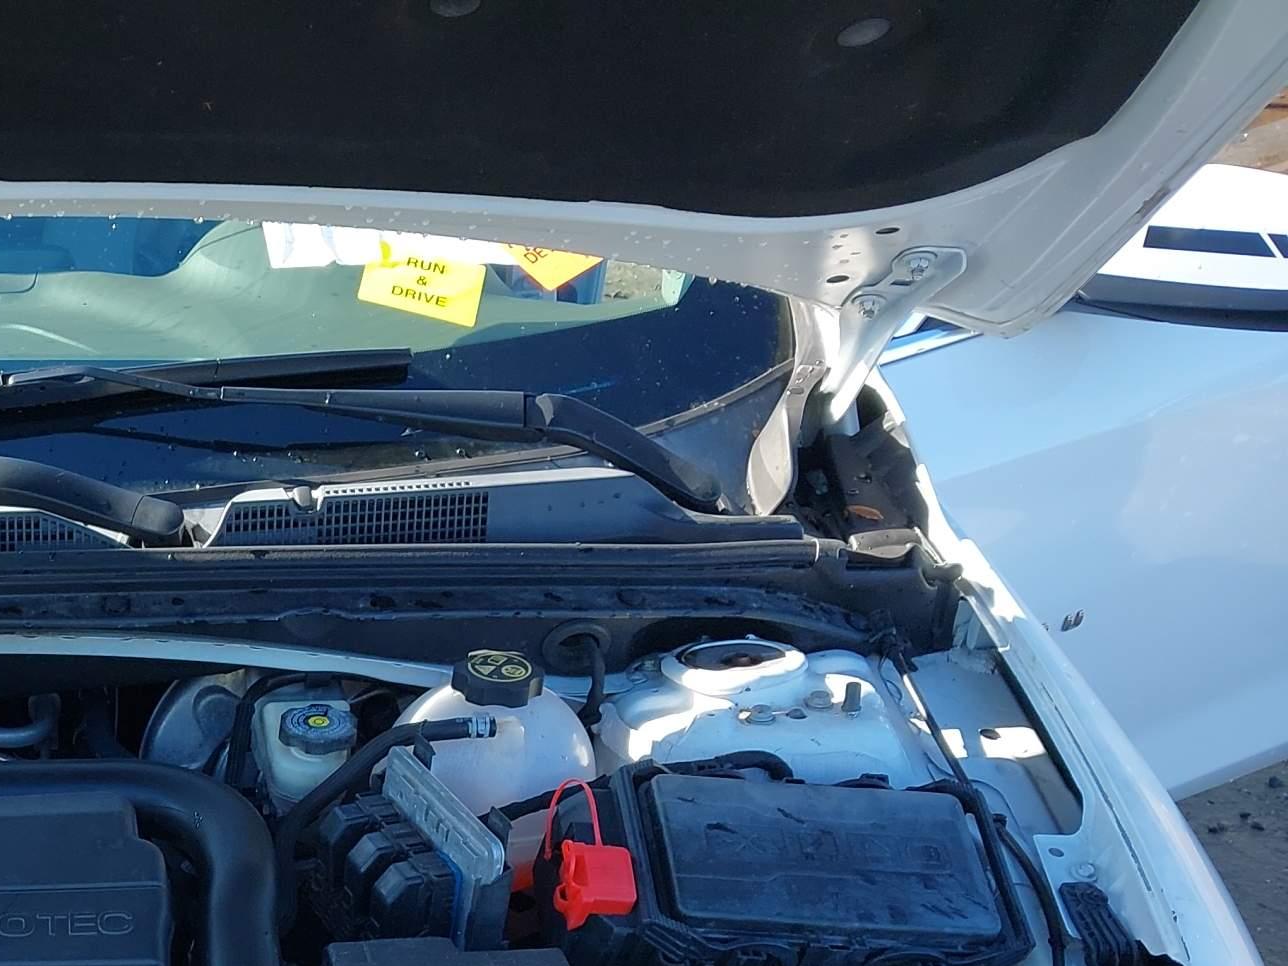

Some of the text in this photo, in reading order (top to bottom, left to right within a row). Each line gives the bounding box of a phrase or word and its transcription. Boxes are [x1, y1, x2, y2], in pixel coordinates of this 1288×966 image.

[406, 257, 446, 275] RUN
[416, 276, 428, 286] &
[391, 285, 449, 308] DRIVE
